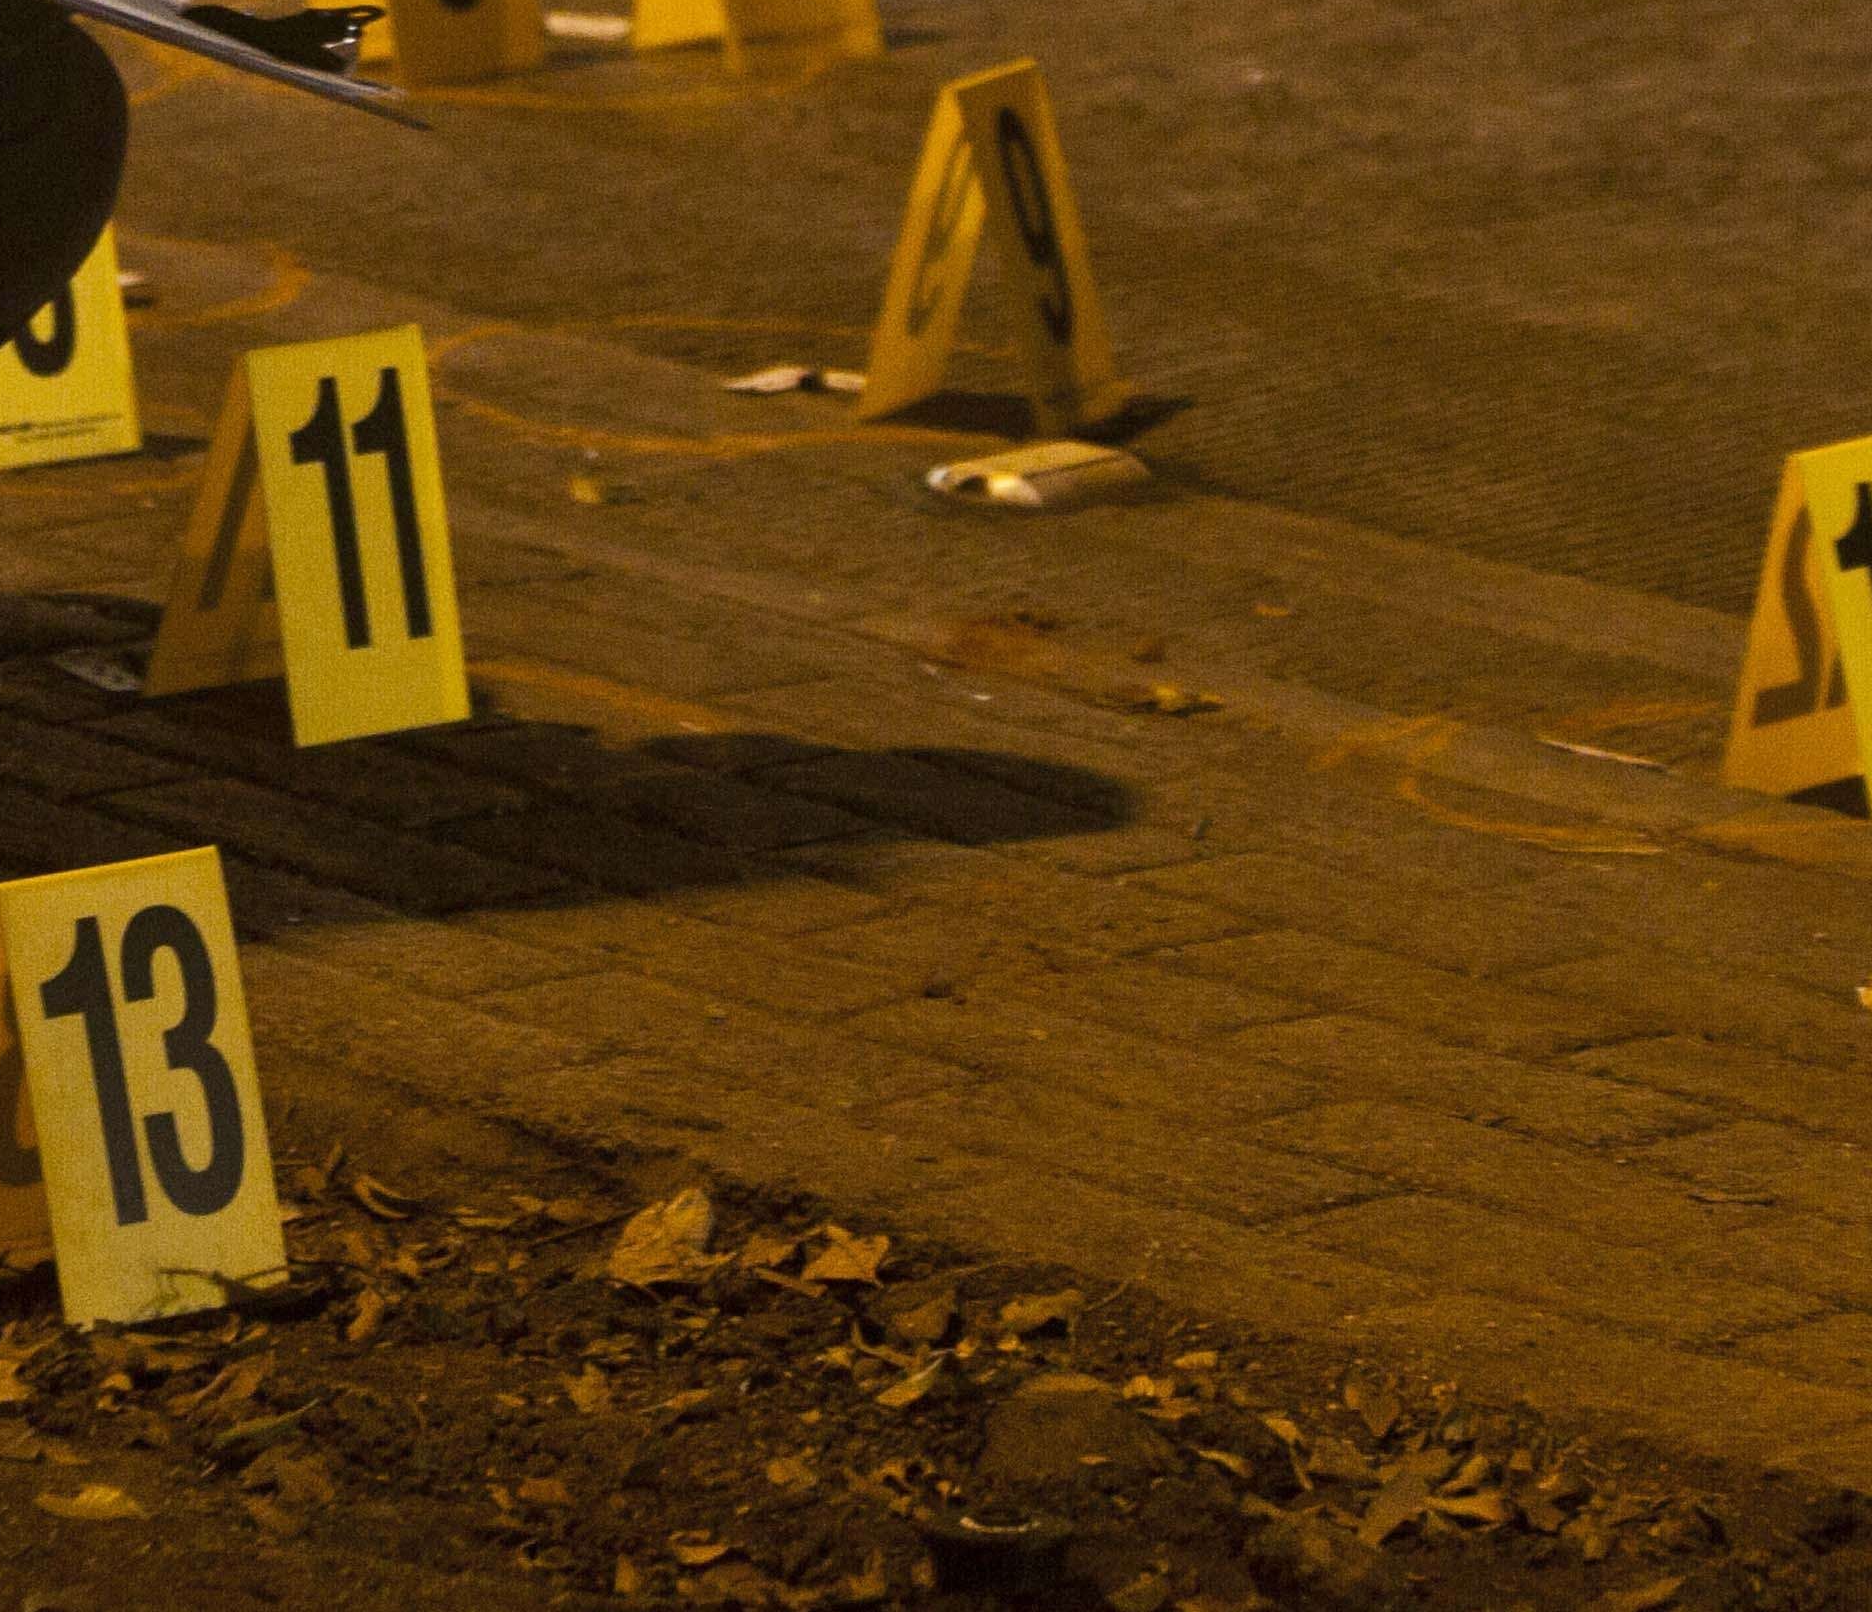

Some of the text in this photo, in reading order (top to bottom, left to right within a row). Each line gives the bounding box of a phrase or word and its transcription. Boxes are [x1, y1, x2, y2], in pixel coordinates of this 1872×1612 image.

[997, 105, 1071, 345] 9
[289, 366, 434, 651] 11
[39, 904, 245, 1227] 13
